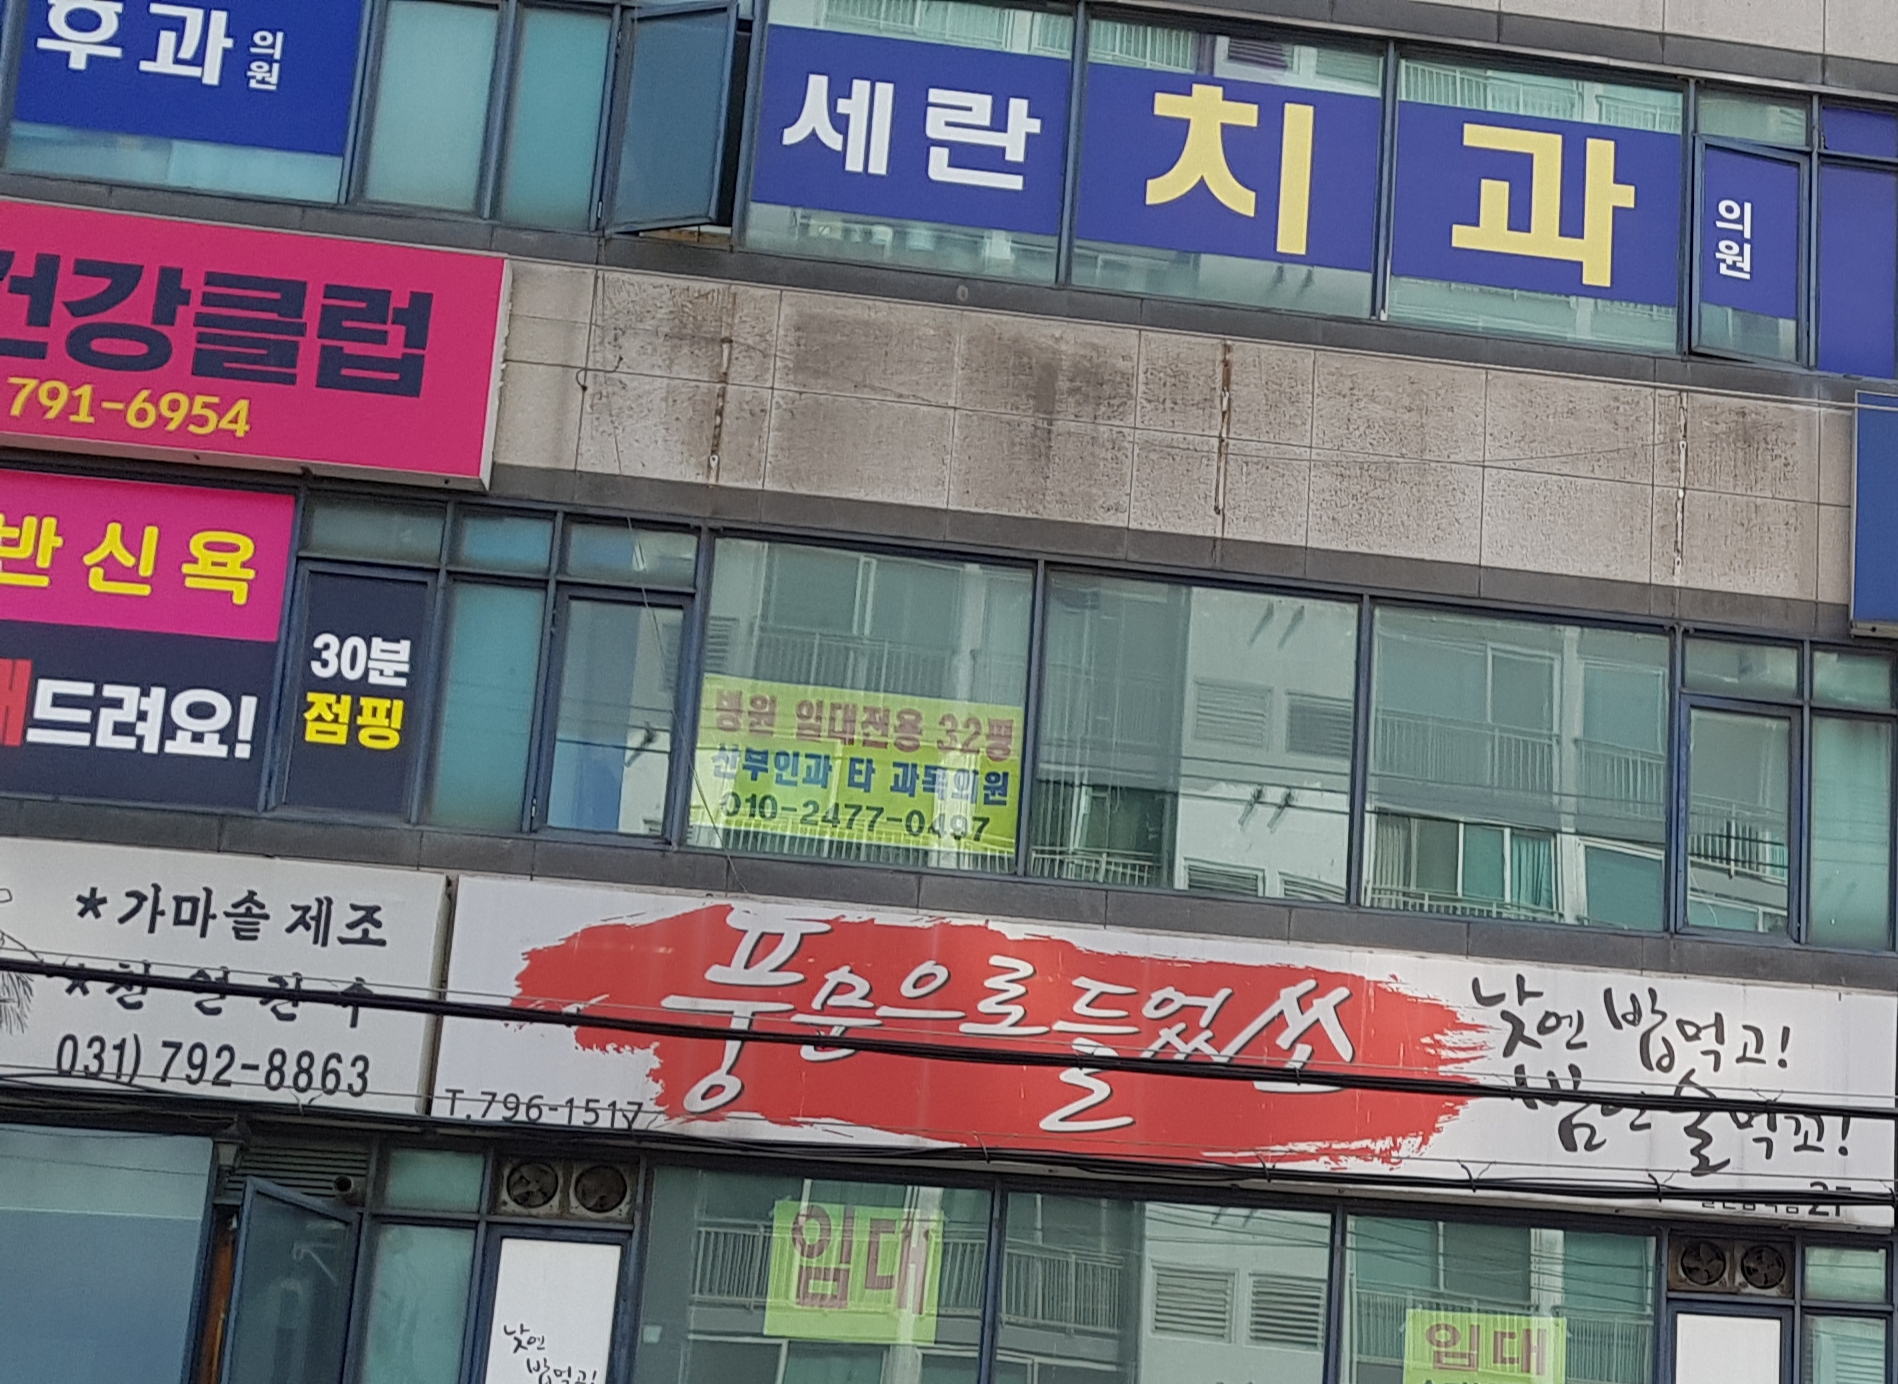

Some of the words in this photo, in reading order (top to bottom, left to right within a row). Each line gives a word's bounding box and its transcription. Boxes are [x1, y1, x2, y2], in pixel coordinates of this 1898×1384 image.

[246, 30, 283, 90] 의원
[782, 74, 1042, 191] 세란
[1714, 199, 1752, 280] 의원
[8, 377, 250, 438] 791-6954
[310, 632, 411, 687] 30분
[304, 690, 404, 751] 점핑
[284, 895, 388, 948] 제조
[791, 1204, 927, 1315] 임대
[1424, 1322, 1548, 1374] 임대
